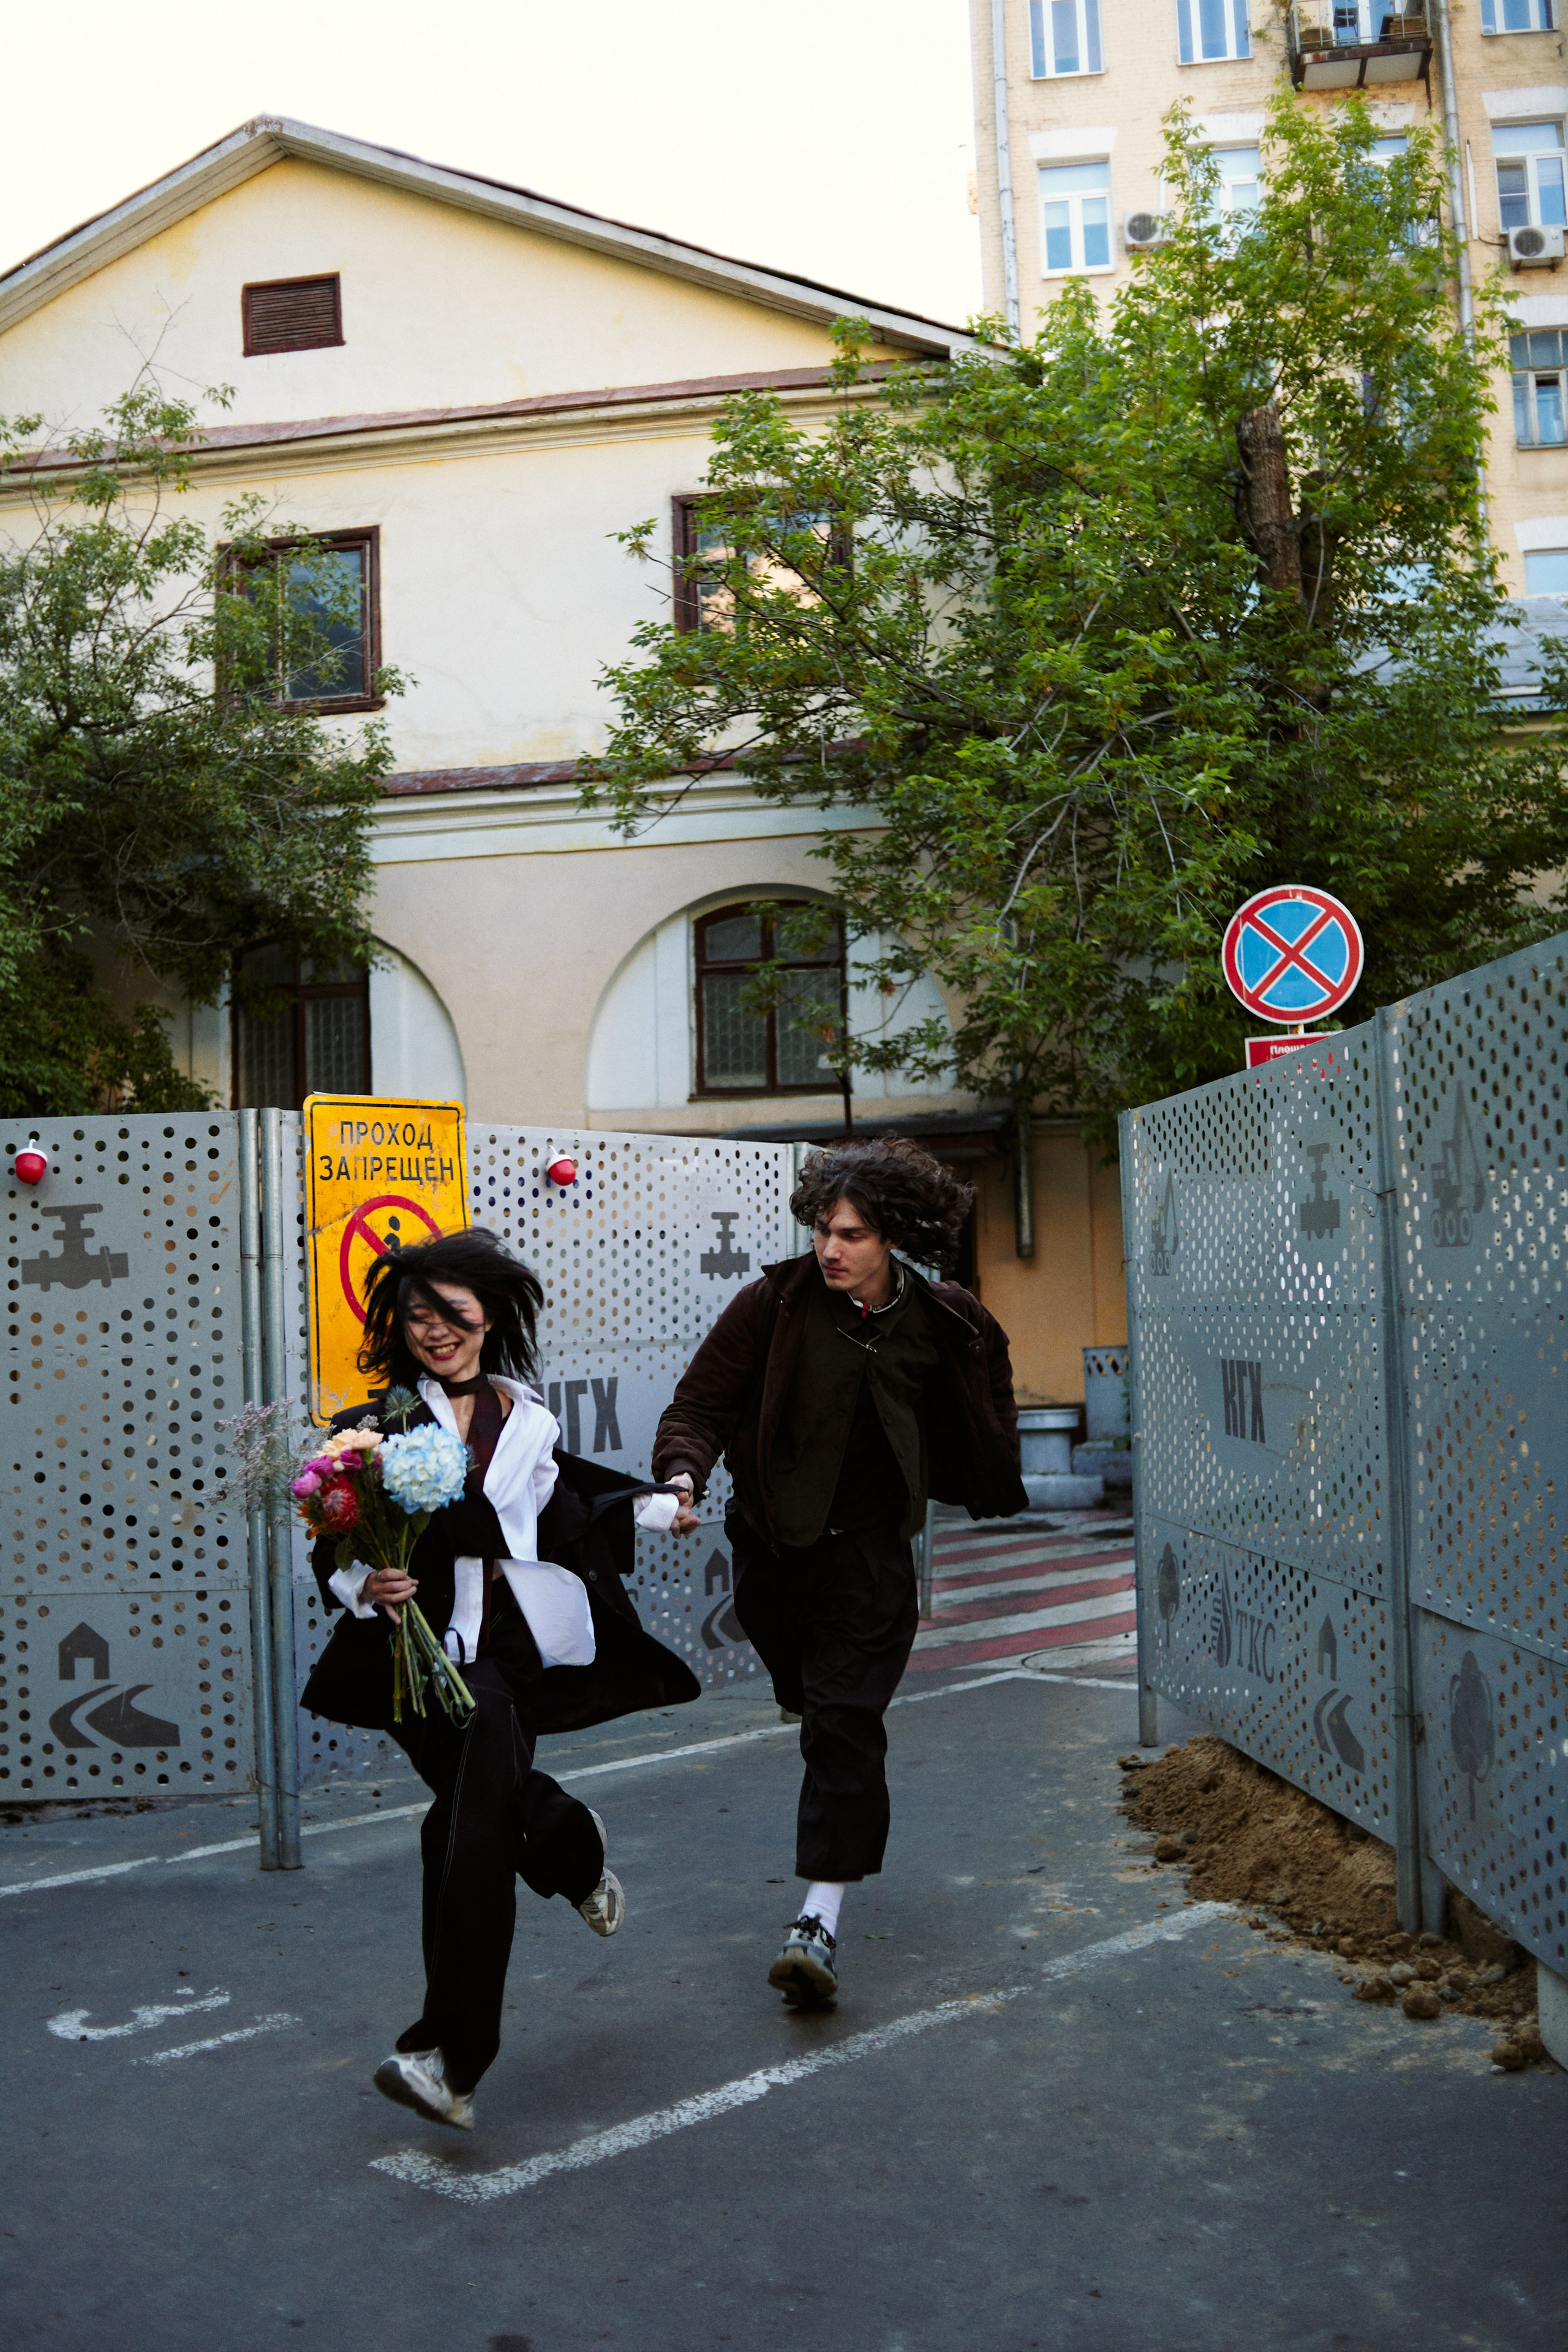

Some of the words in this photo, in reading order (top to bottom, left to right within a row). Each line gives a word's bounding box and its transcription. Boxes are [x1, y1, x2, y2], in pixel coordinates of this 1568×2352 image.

[341, 1121, 434, 1150] ПРОХОД
[319, 1155, 454, 1185] ЗАПРЕЩЕН
[1221, 1359, 1266, 1444] КГХ
[1235, 1608, 1276, 1684] ТКС
